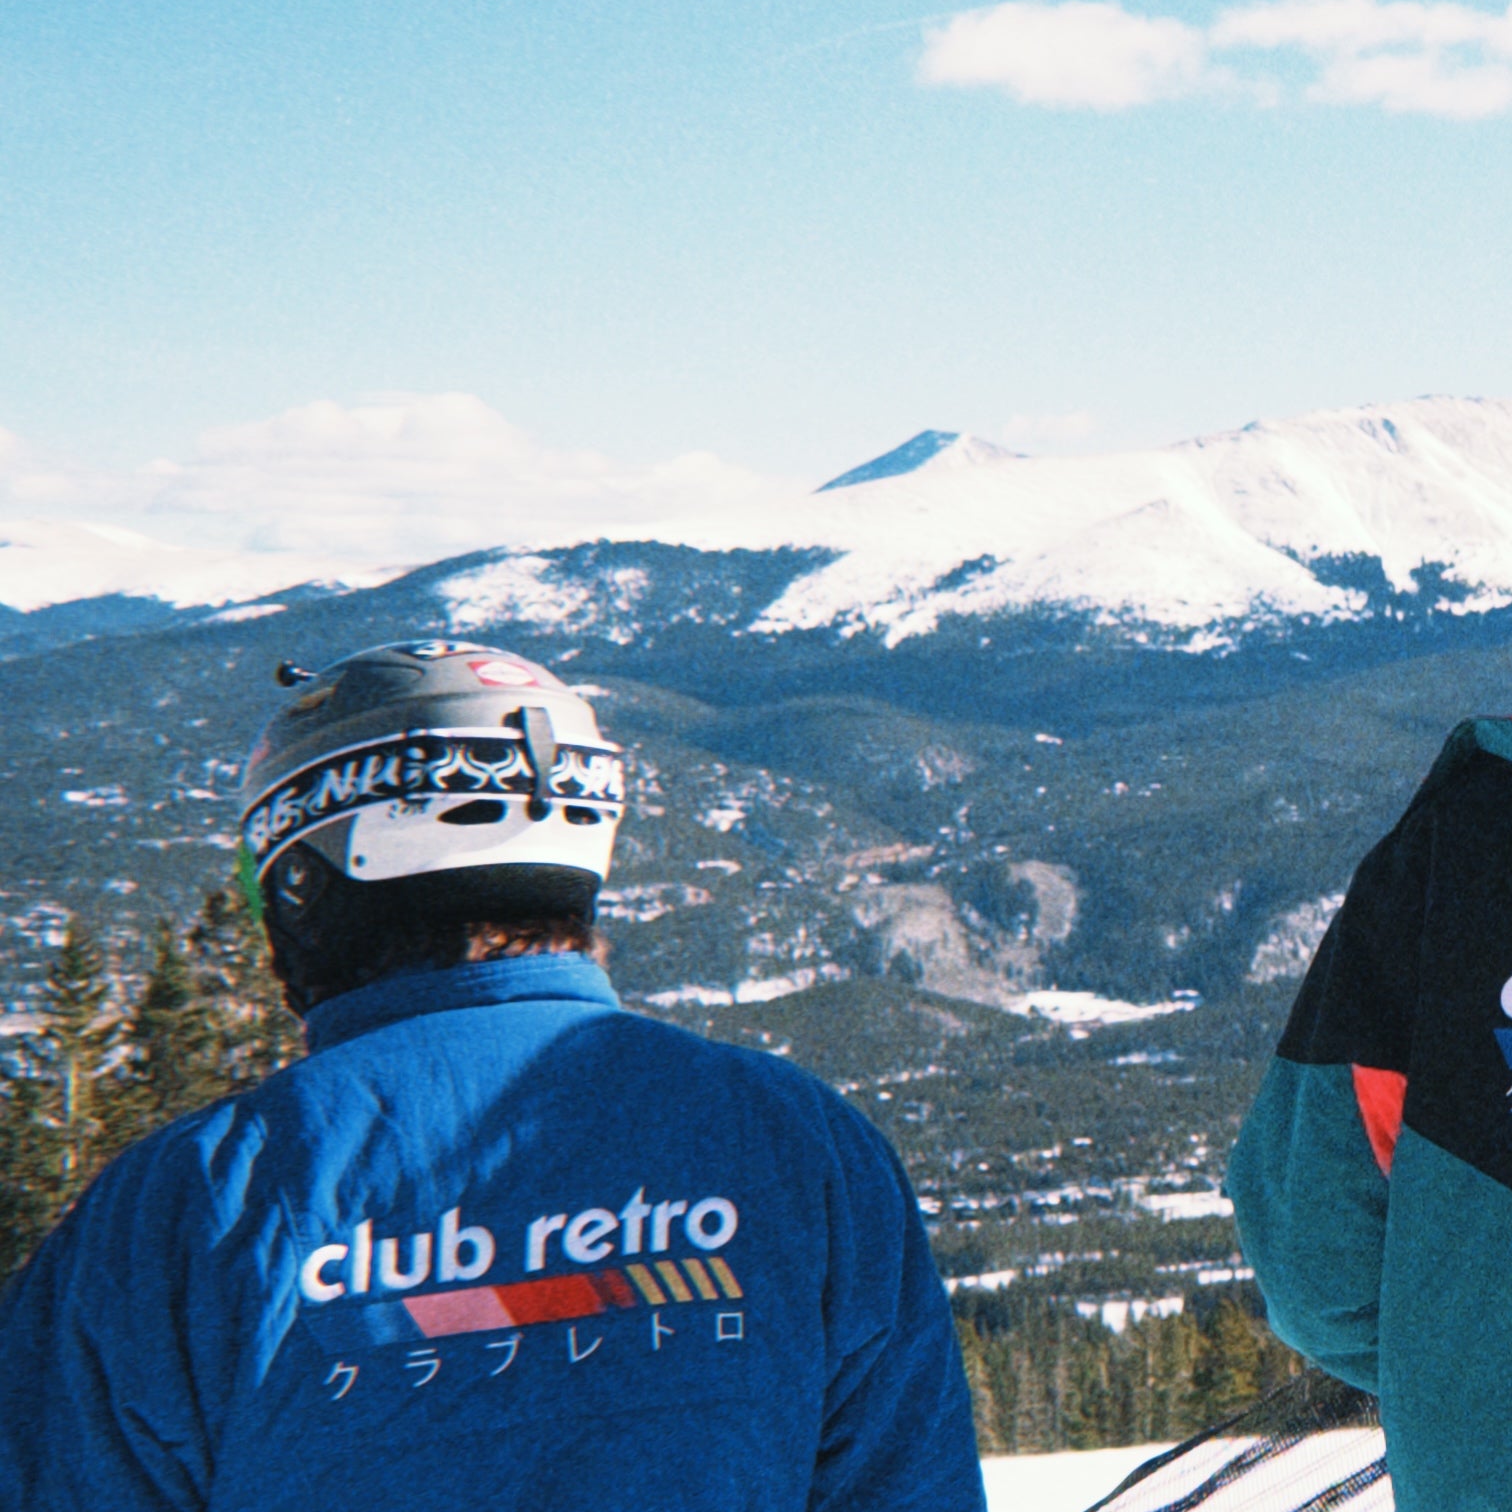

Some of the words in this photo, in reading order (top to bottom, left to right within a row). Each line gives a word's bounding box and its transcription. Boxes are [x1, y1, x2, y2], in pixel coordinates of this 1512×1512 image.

[298, 1206, 497, 1303] club
[525, 1186, 740, 1273] retro
[323, 1310, 745, 1402] クラブレトロ
